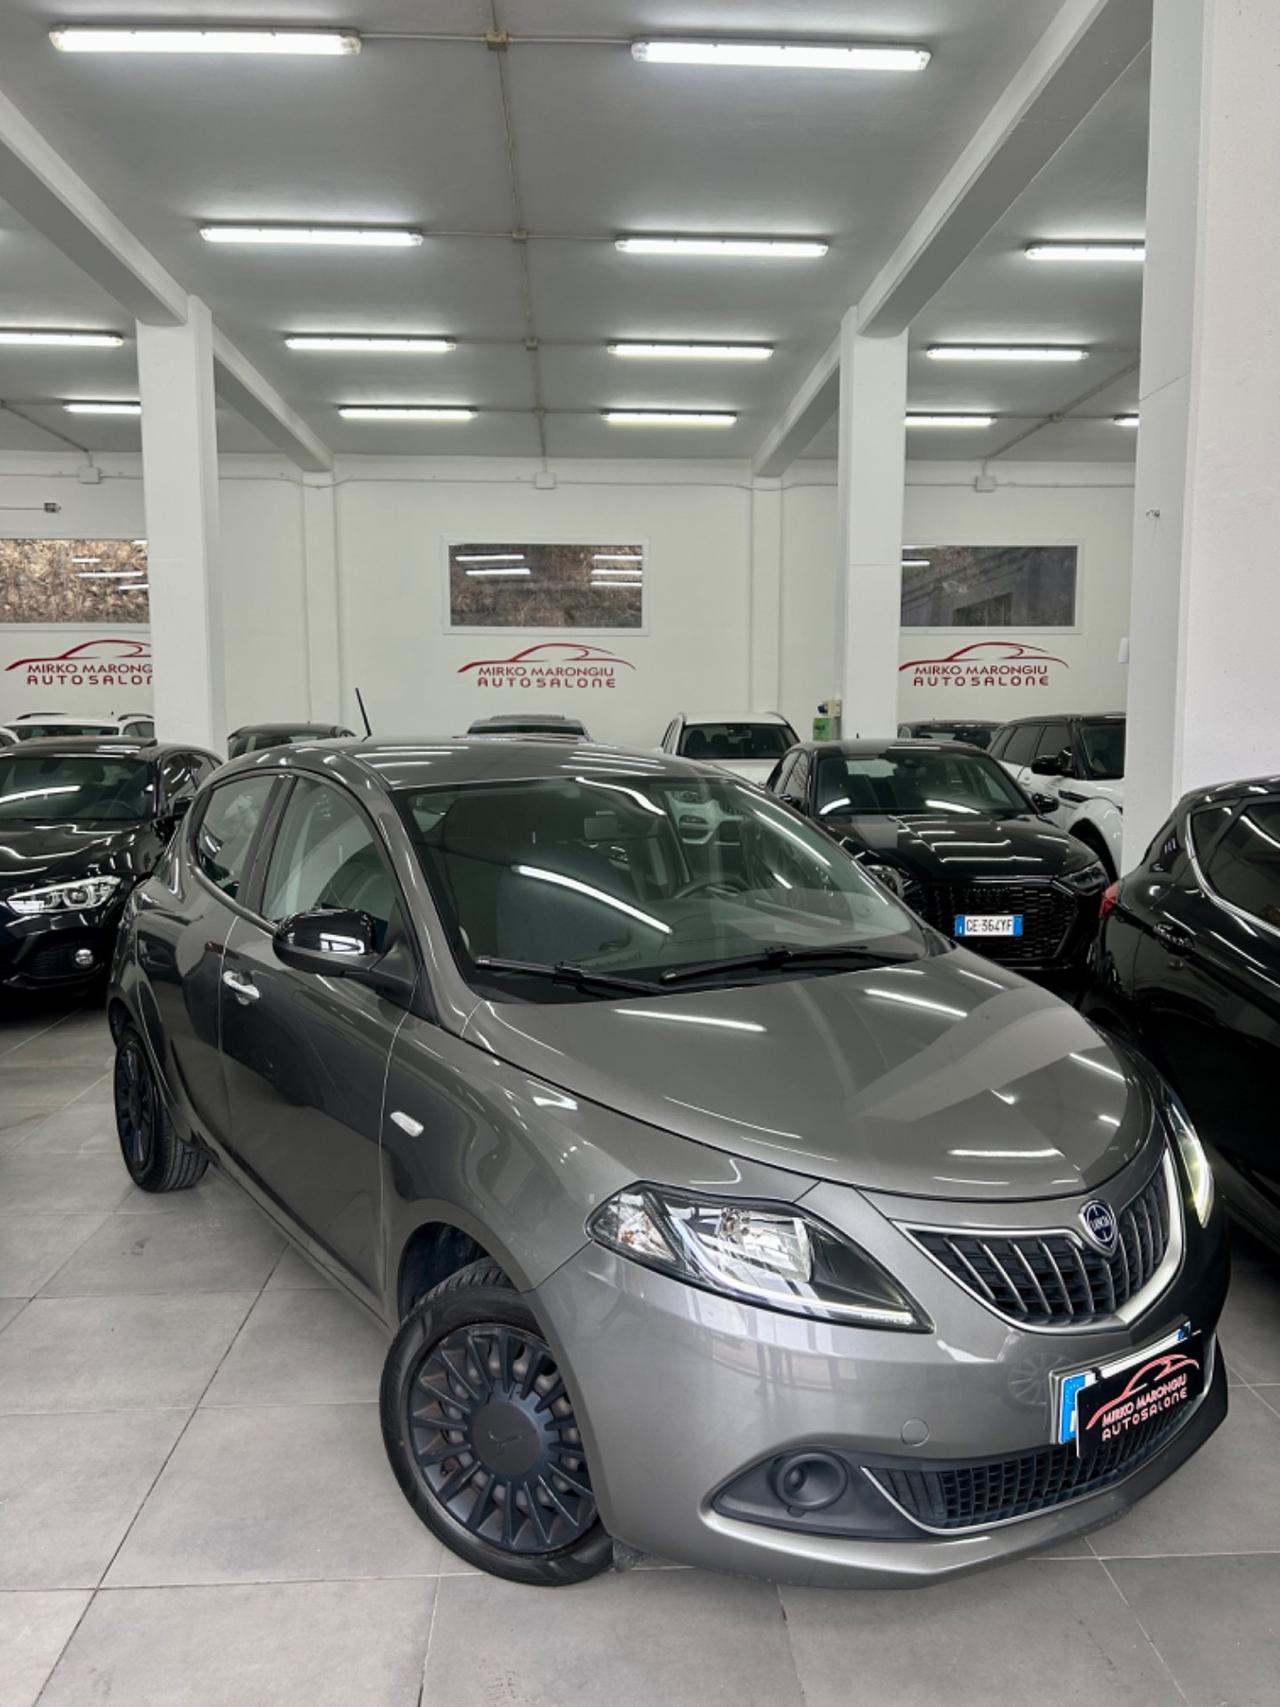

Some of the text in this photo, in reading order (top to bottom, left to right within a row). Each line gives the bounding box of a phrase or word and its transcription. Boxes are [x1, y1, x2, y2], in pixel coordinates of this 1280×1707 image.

[27, 663, 153, 674] MIRKO MARONG
[478, 666, 615, 677] MIRKO MARONGIU
[914, 664, 1048, 675] MIRKO MARONGIU
[477, 677, 616, 688] AUTOSALONE
[913, 675, 1048, 687] AUTOSALONE
[1101, 1386, 1188, 1442] AUTOSALONE
